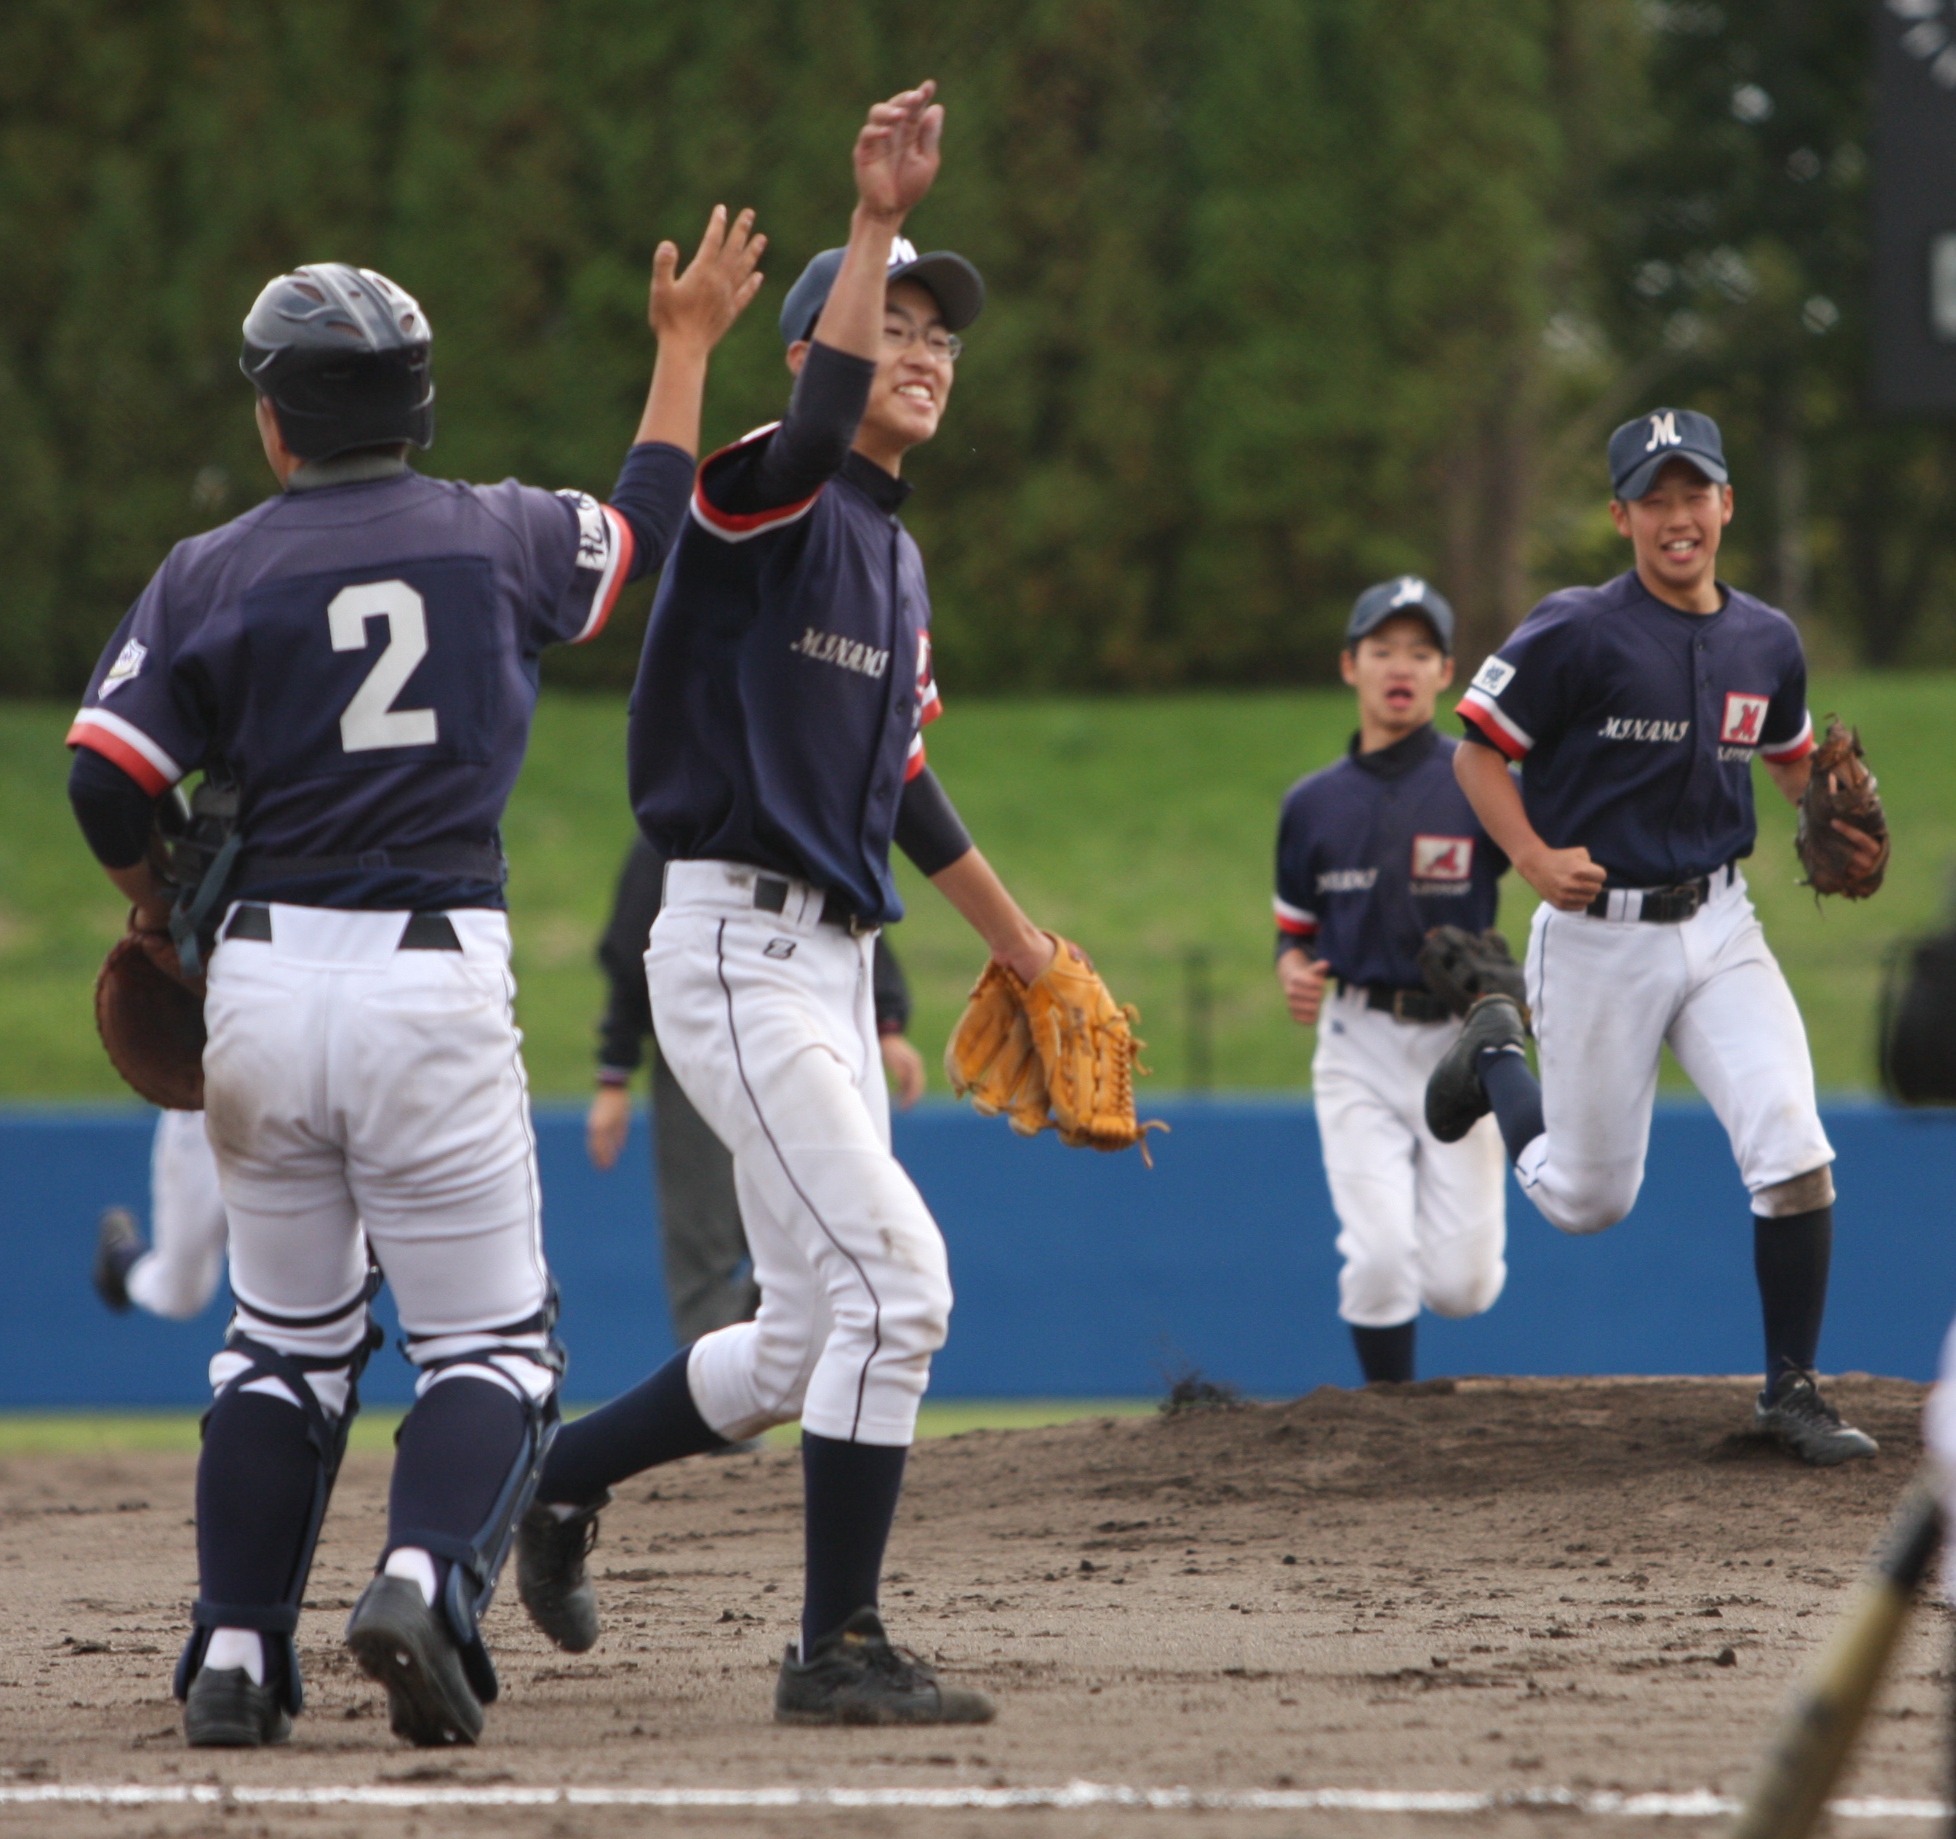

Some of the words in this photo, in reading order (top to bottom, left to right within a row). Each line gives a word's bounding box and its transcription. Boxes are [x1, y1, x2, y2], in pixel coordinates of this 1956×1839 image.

[886, 235, 918, 266] M
[1645, 411, 1682, 452] M
[1390, 576, 1425, 607] M
[327, 578, 438, 753] 2
[1598, 716, 1690, 743] MINAMI
